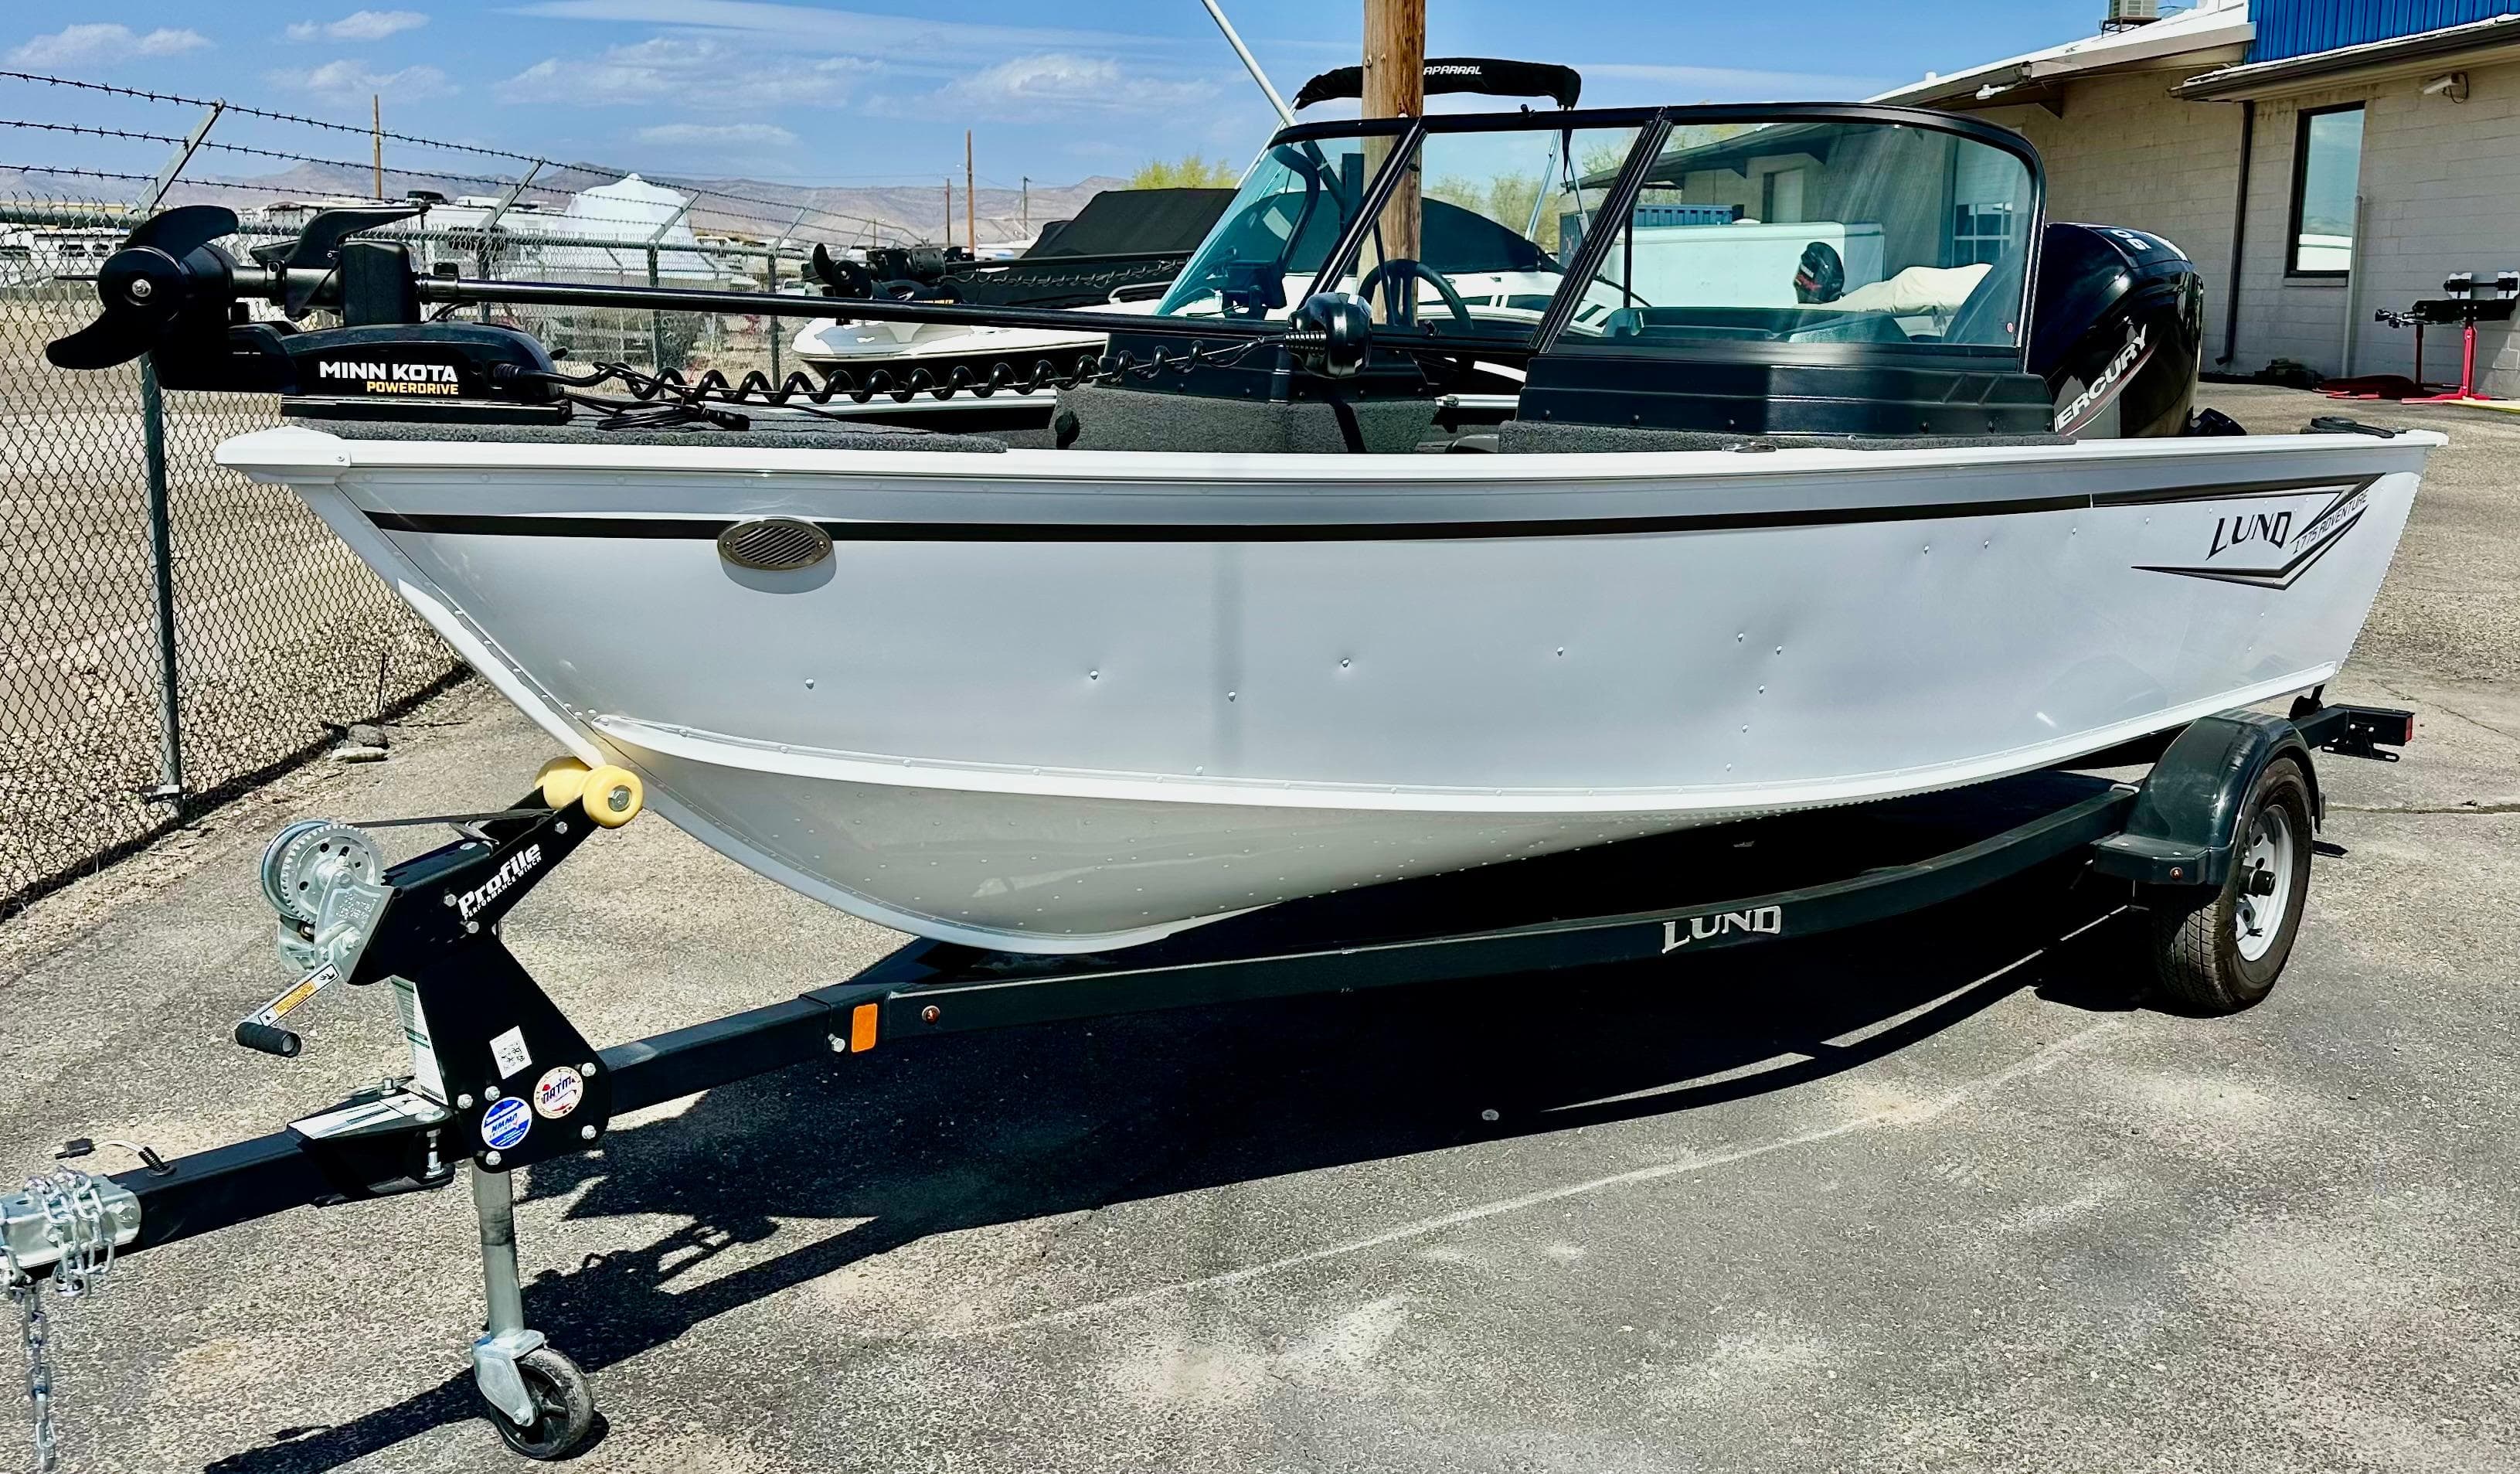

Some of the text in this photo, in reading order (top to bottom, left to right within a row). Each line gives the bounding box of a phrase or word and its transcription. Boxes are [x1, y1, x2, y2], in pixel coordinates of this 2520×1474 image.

[1423, 65, 1482, 76] APARRAL
[319, 361, 458, 383] MINN KOTA
[366, 381, 459, 395] POWERDRIVE
[2054, 323, 2147, 433] ERCURY
[2205, 511, 2292, 561] LUND
[2318, 488, 2369, 539] ADVENTURE
[457, 843, 541, 916] Profile
[464, 875, 517, 921] PERFORMANCE
[1661, 905, 1782, 955] LUND
